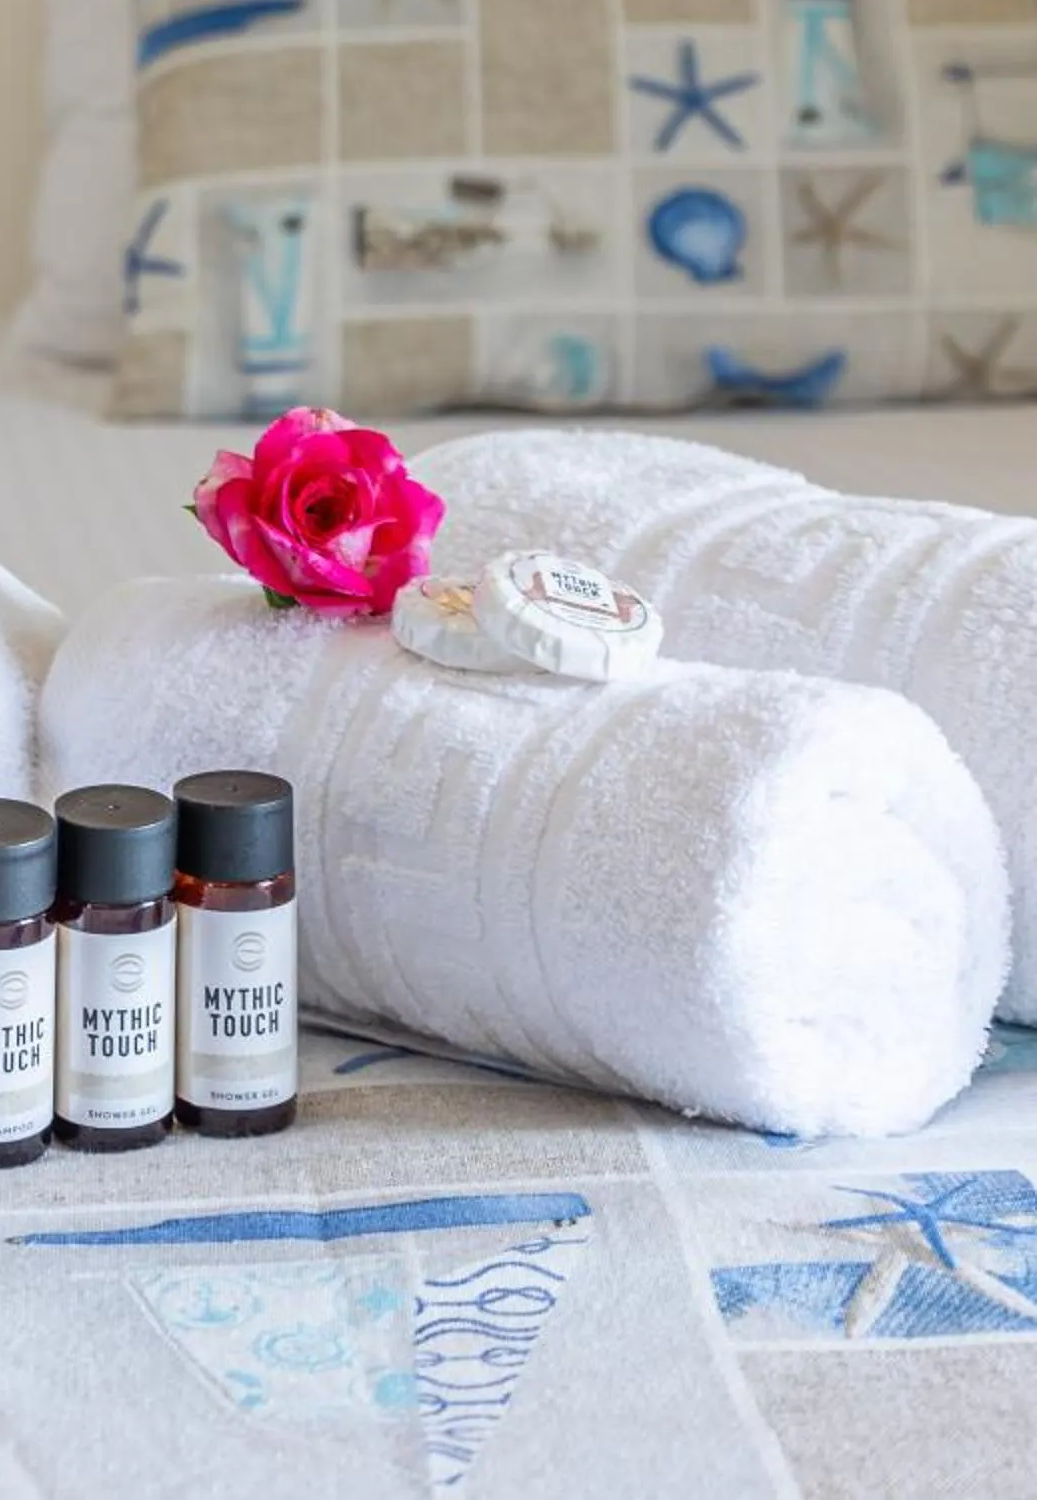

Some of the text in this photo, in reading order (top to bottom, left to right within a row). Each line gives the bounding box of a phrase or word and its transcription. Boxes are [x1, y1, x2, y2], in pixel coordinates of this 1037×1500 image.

[204, 982, 284, 1011] MYTHIC
[82, 1002, 163, 1032] MYTHIC
[210, 1009, 279, 1037] TOUCH
[87, 1030, 158, 1057] TOUCH
[210, 1090, 258, 1102] SHOWER
[87, 1108, 136, 1120] SHOWER
